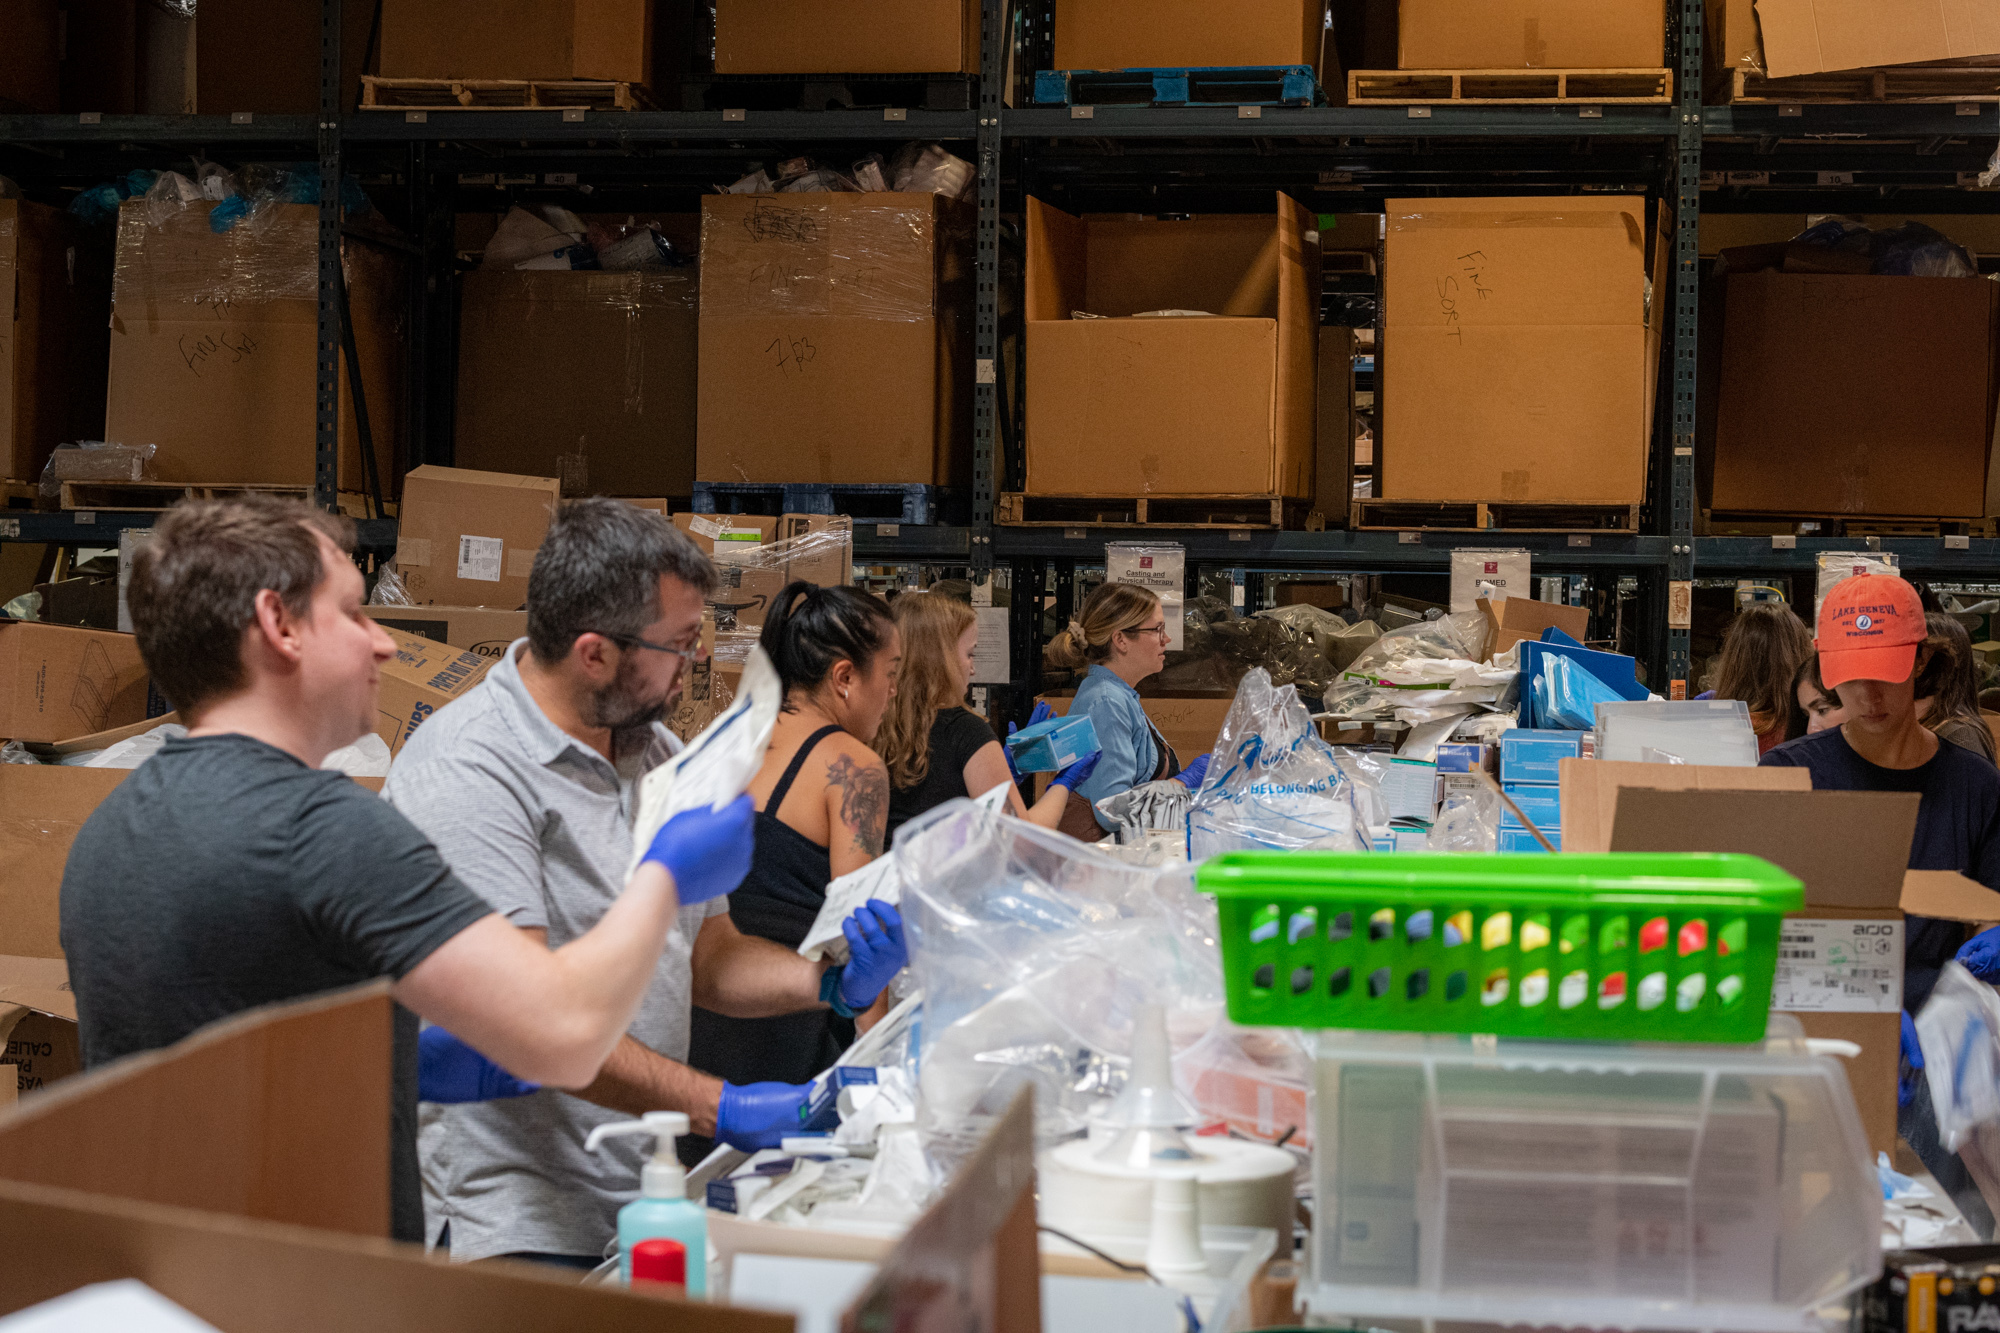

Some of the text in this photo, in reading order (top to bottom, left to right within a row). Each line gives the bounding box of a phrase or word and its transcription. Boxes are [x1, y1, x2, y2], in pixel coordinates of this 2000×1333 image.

[1436, 275, 1462, 346] SORT
[1126, 569, 1152, 578] Casting
[1147, 577, 1174, 586] Therapy
[1832, 604, 1898, 620] LAKE GENEVA
[478, 646, 507, 658] DA
[426, 669, 462, 692] PAPER
[445, 659, 473, 678] HOT
[1250, 778, 1326, 795] BELONGING
